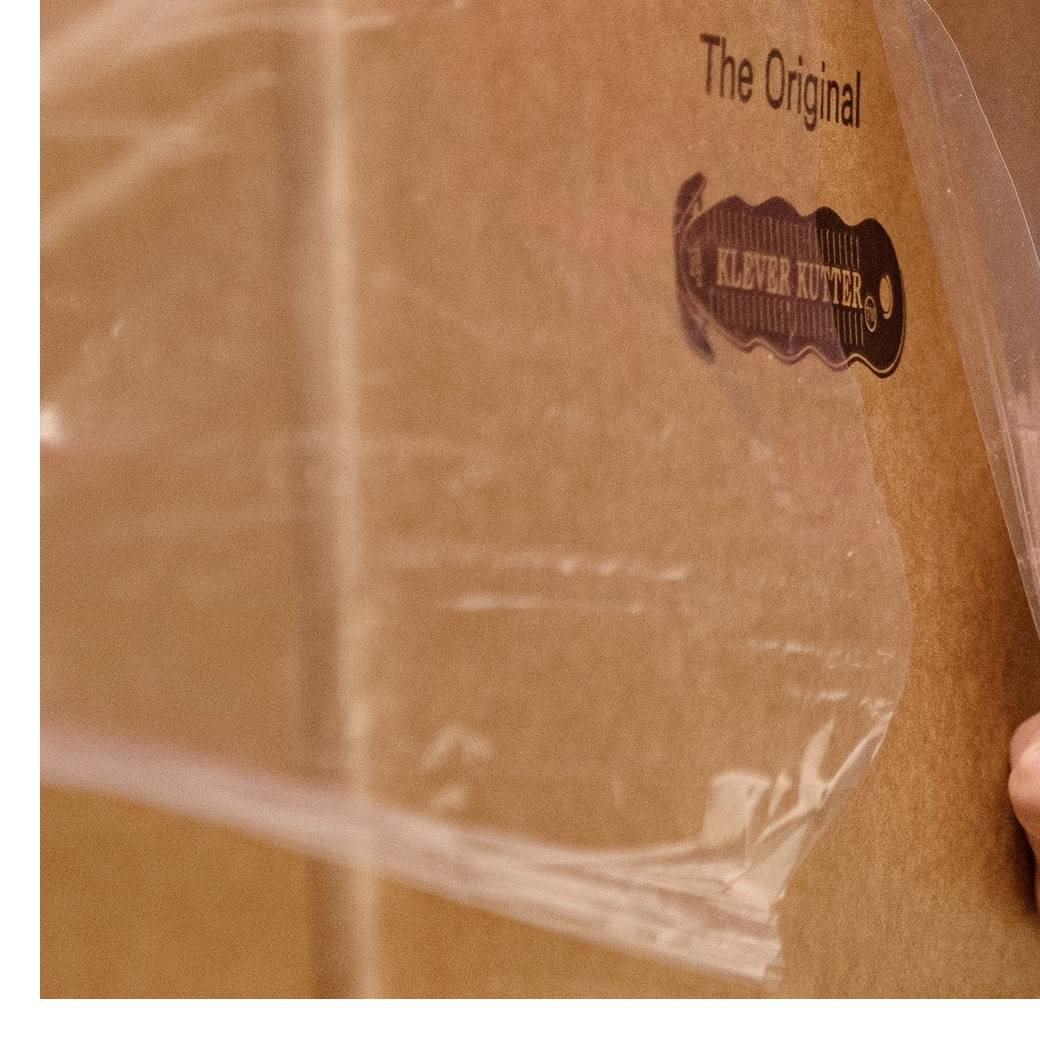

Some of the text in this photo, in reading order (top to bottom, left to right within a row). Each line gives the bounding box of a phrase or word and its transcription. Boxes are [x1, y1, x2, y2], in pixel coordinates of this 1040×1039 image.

[699, 33, 862, 131] The Original
[716, 248, 791, 298] KLEVER
[796, 261, 865, 310] KUTTER
